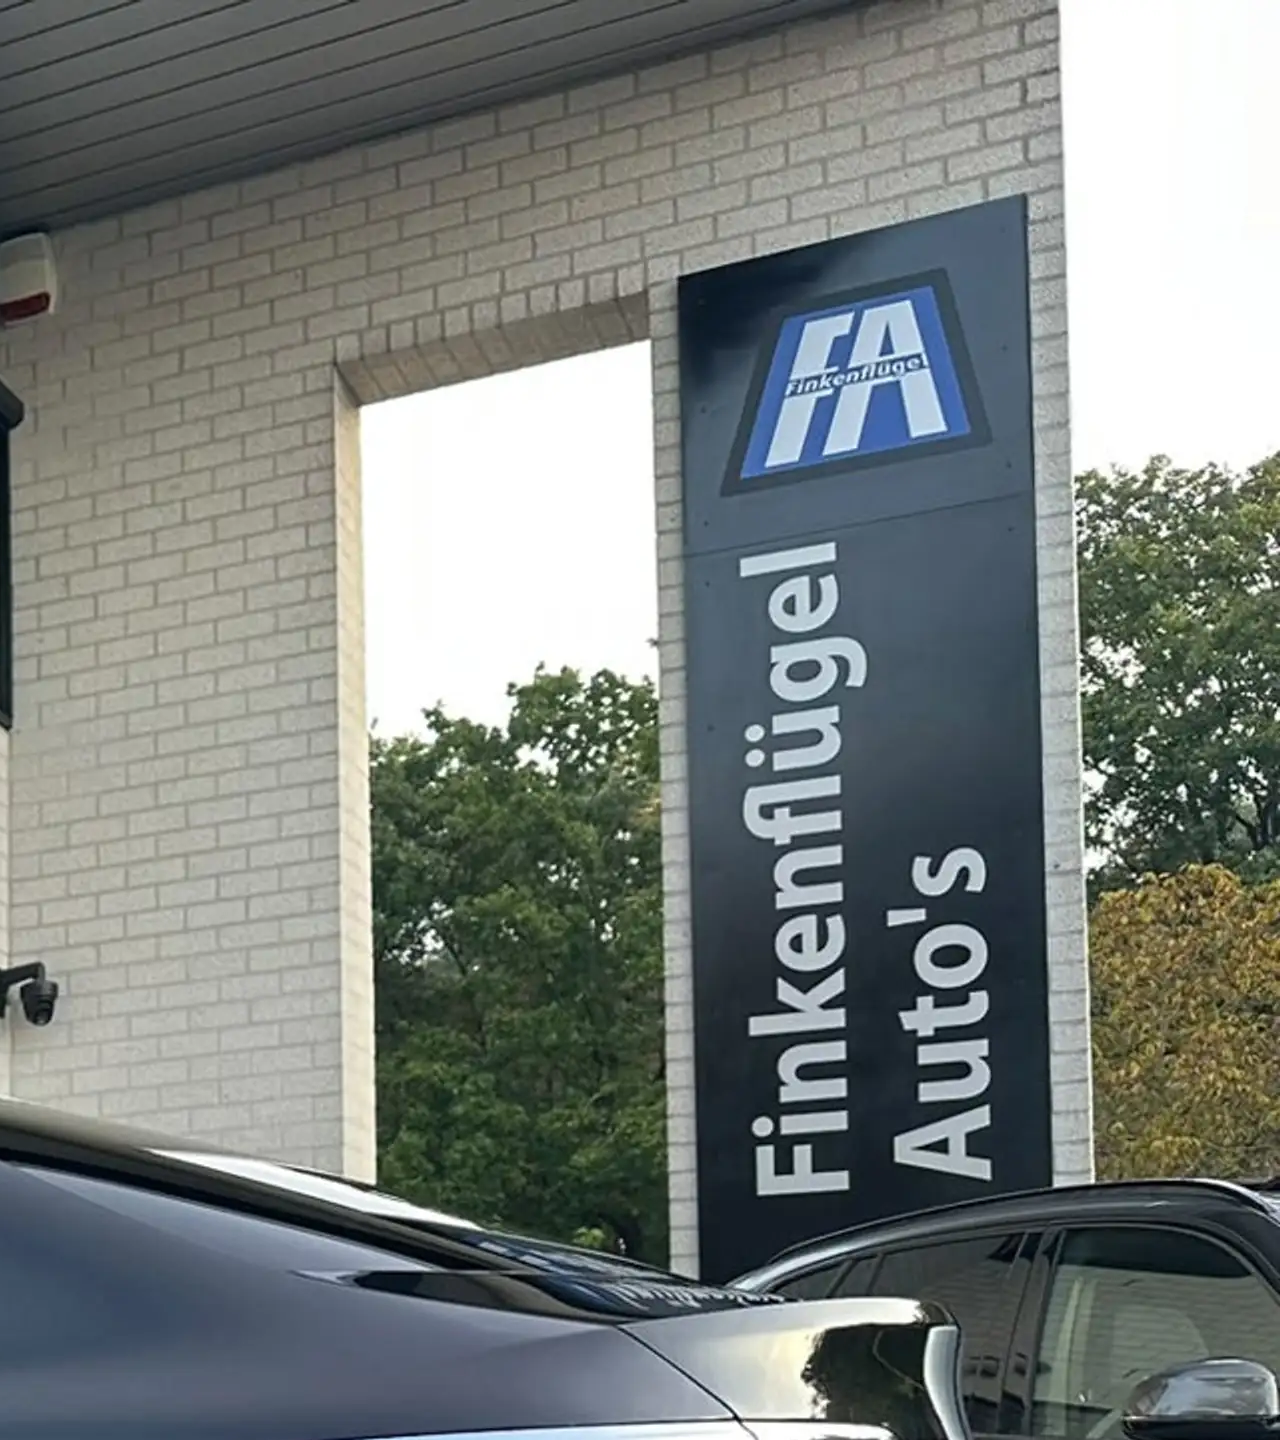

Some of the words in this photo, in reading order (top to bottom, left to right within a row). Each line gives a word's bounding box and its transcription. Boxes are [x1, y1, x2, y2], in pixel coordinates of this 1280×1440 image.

[784, 352, 930, 398] Finkenflügel
[739, 540, 868, 1196] Finkenflügel
[886, 845, 993, 1182] Auto's
